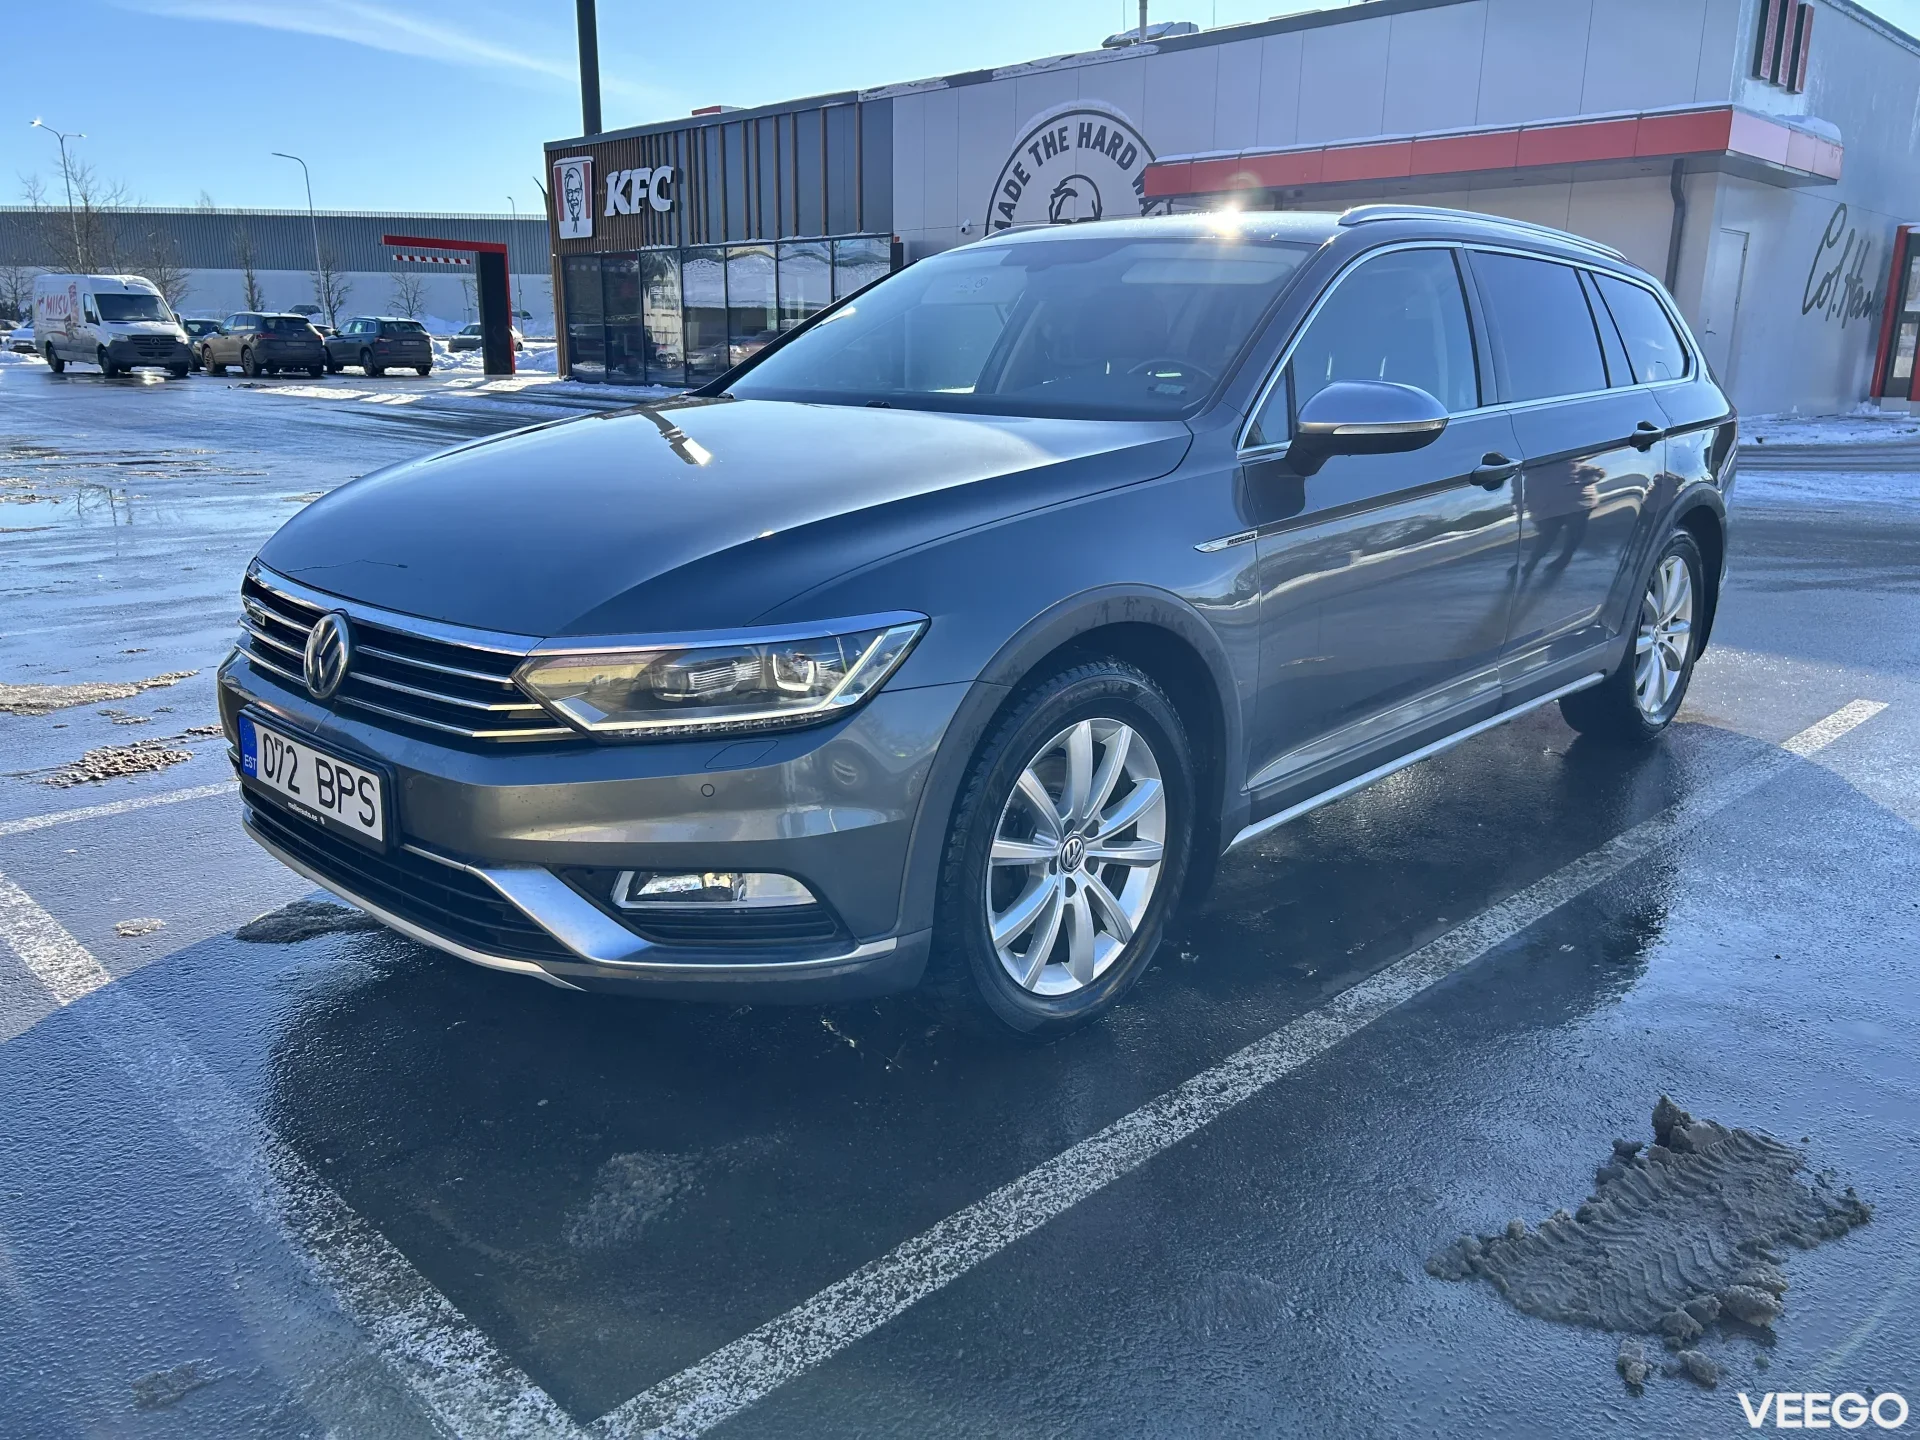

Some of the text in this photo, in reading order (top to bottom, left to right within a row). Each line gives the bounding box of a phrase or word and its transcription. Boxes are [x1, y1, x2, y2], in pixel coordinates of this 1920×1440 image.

[1028, 126, 1070, 168] THE
[1077, 122, 1138, 171] HARD
[604, 165, 674, 217] KFC
[244, 753, 257, 771] EST
[262, 732, 376, 828] 072 BPS
